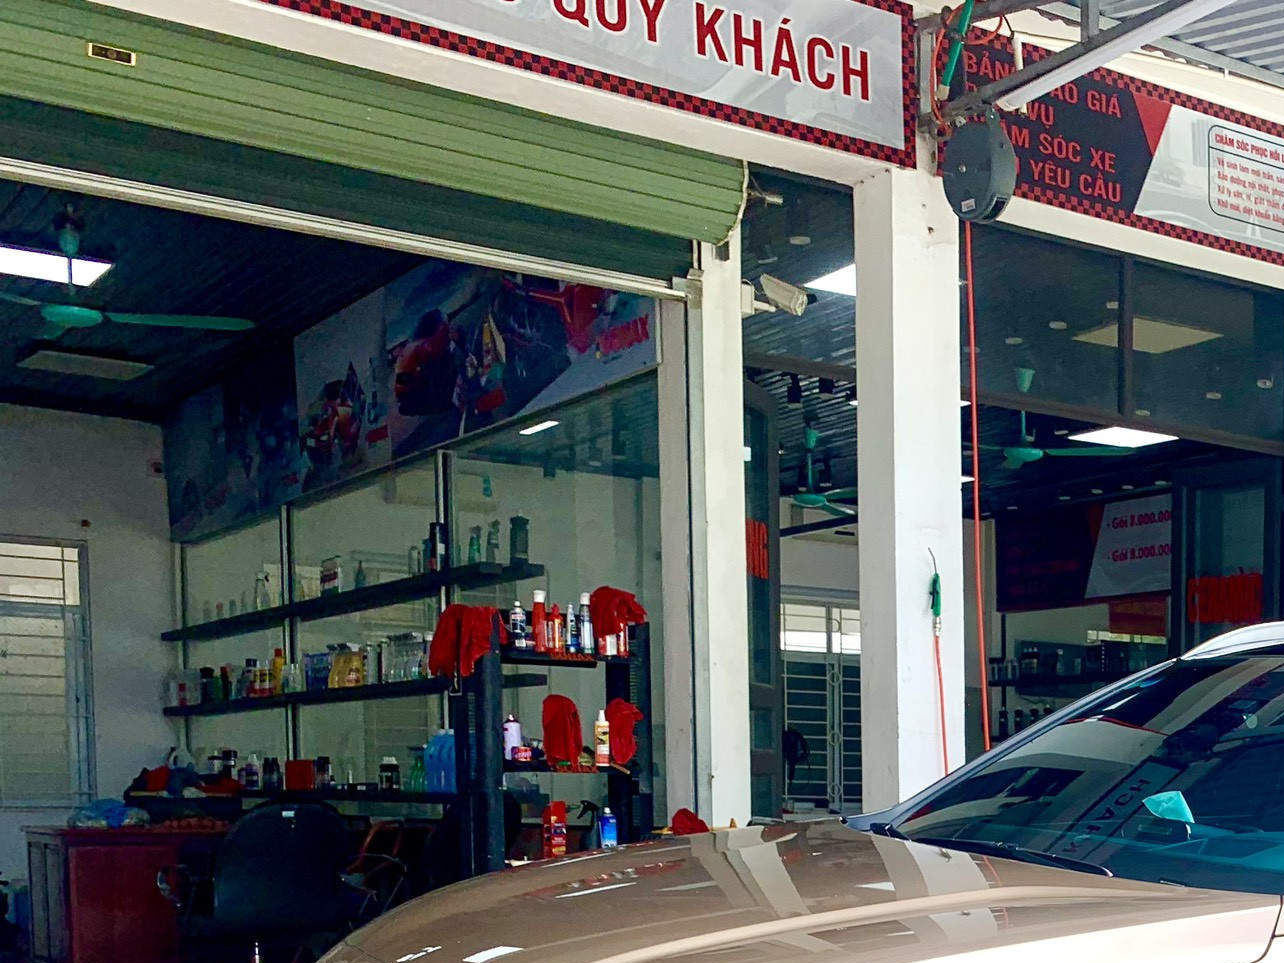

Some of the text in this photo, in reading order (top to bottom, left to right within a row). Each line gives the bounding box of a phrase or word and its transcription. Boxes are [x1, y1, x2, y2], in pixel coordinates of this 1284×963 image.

[694, 2, 871, 101] KHÁCH
[964, 46, 1017, 86] BẢN
[1088, 87, 1121, 118] GIÁ
[1030, 156, 1121, 204] YÊU CẦU
[1039, 130, 1116, 174] SÓC XE
